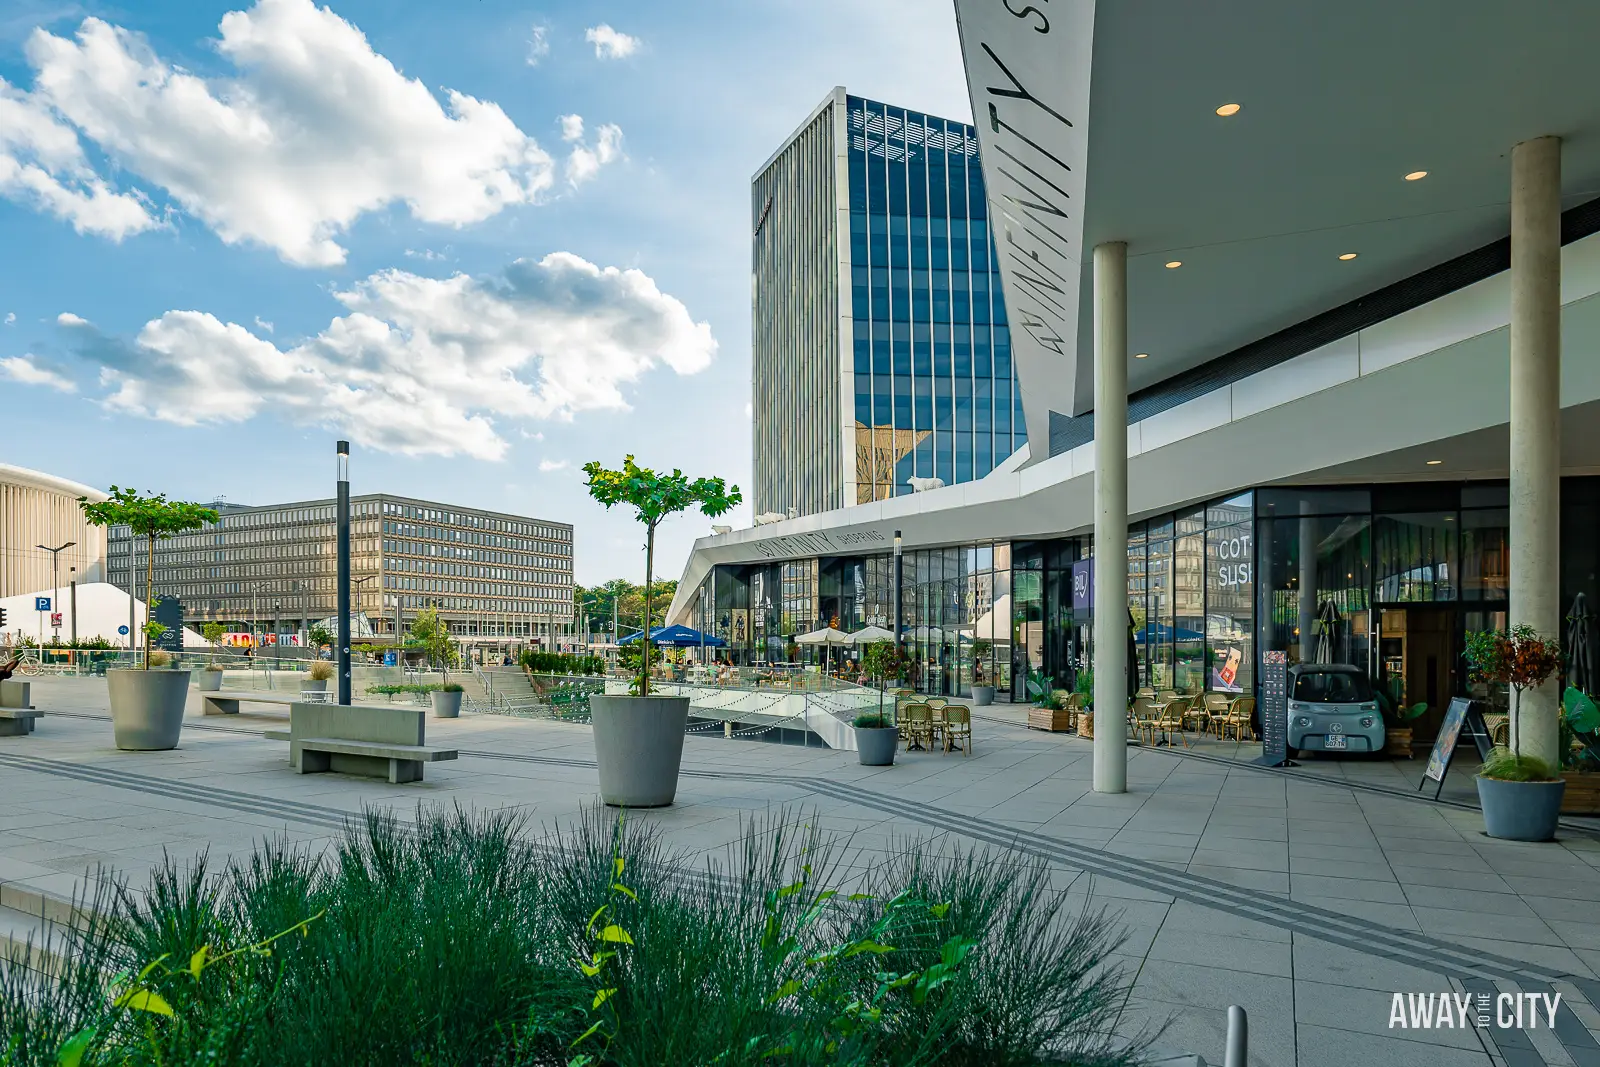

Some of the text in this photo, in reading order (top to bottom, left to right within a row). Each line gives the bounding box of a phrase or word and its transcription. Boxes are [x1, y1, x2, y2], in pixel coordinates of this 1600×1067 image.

[981, 0, 1073, 321] INFINITY S
[766, 530, 885, 556] INFINITY SHOPPING
[1219, 535, 1252, 560] COT
[39, 598, 48, 609] P
